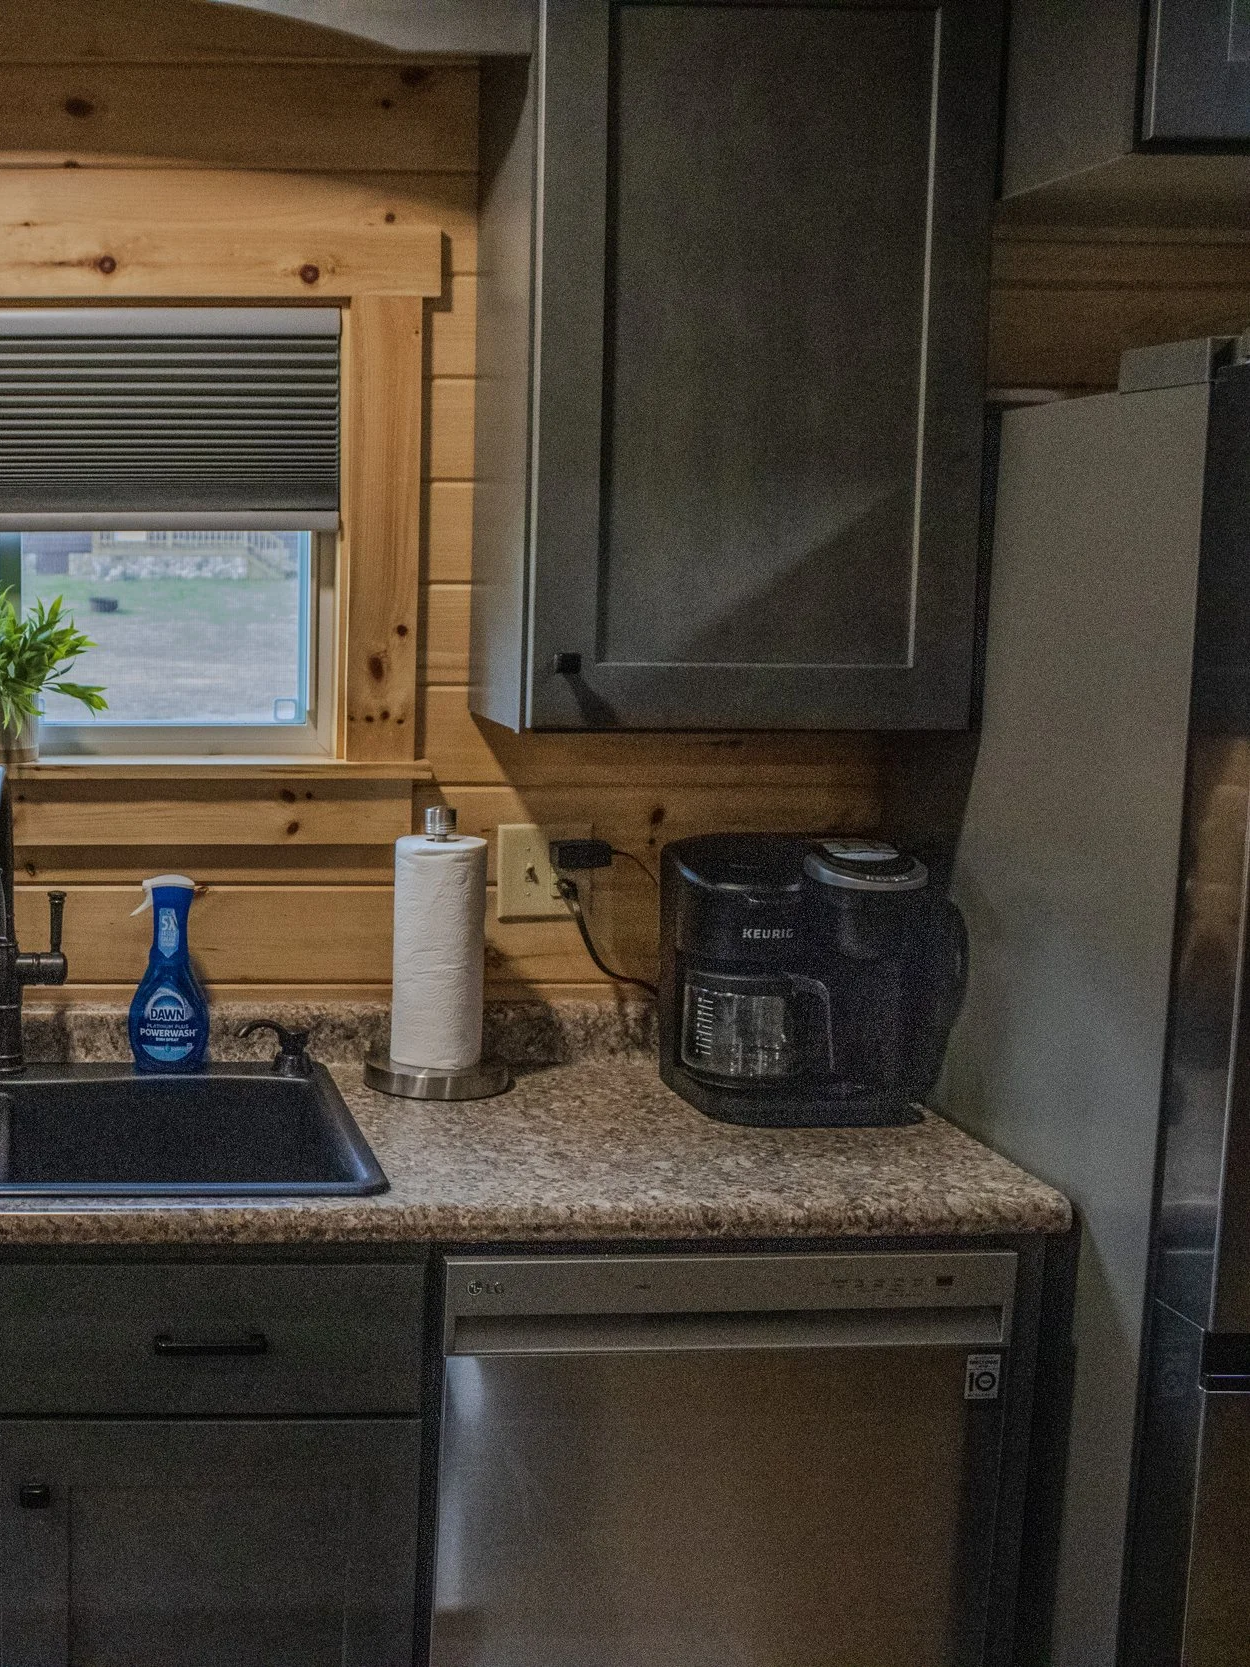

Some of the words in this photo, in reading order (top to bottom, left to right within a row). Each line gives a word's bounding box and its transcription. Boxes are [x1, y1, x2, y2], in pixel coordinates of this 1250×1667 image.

[742, 928, 794, 938] KEURIG
[150, 1008, 185, 1020] DAWN
[140, 1028, 196, 1037] POWERWASH
